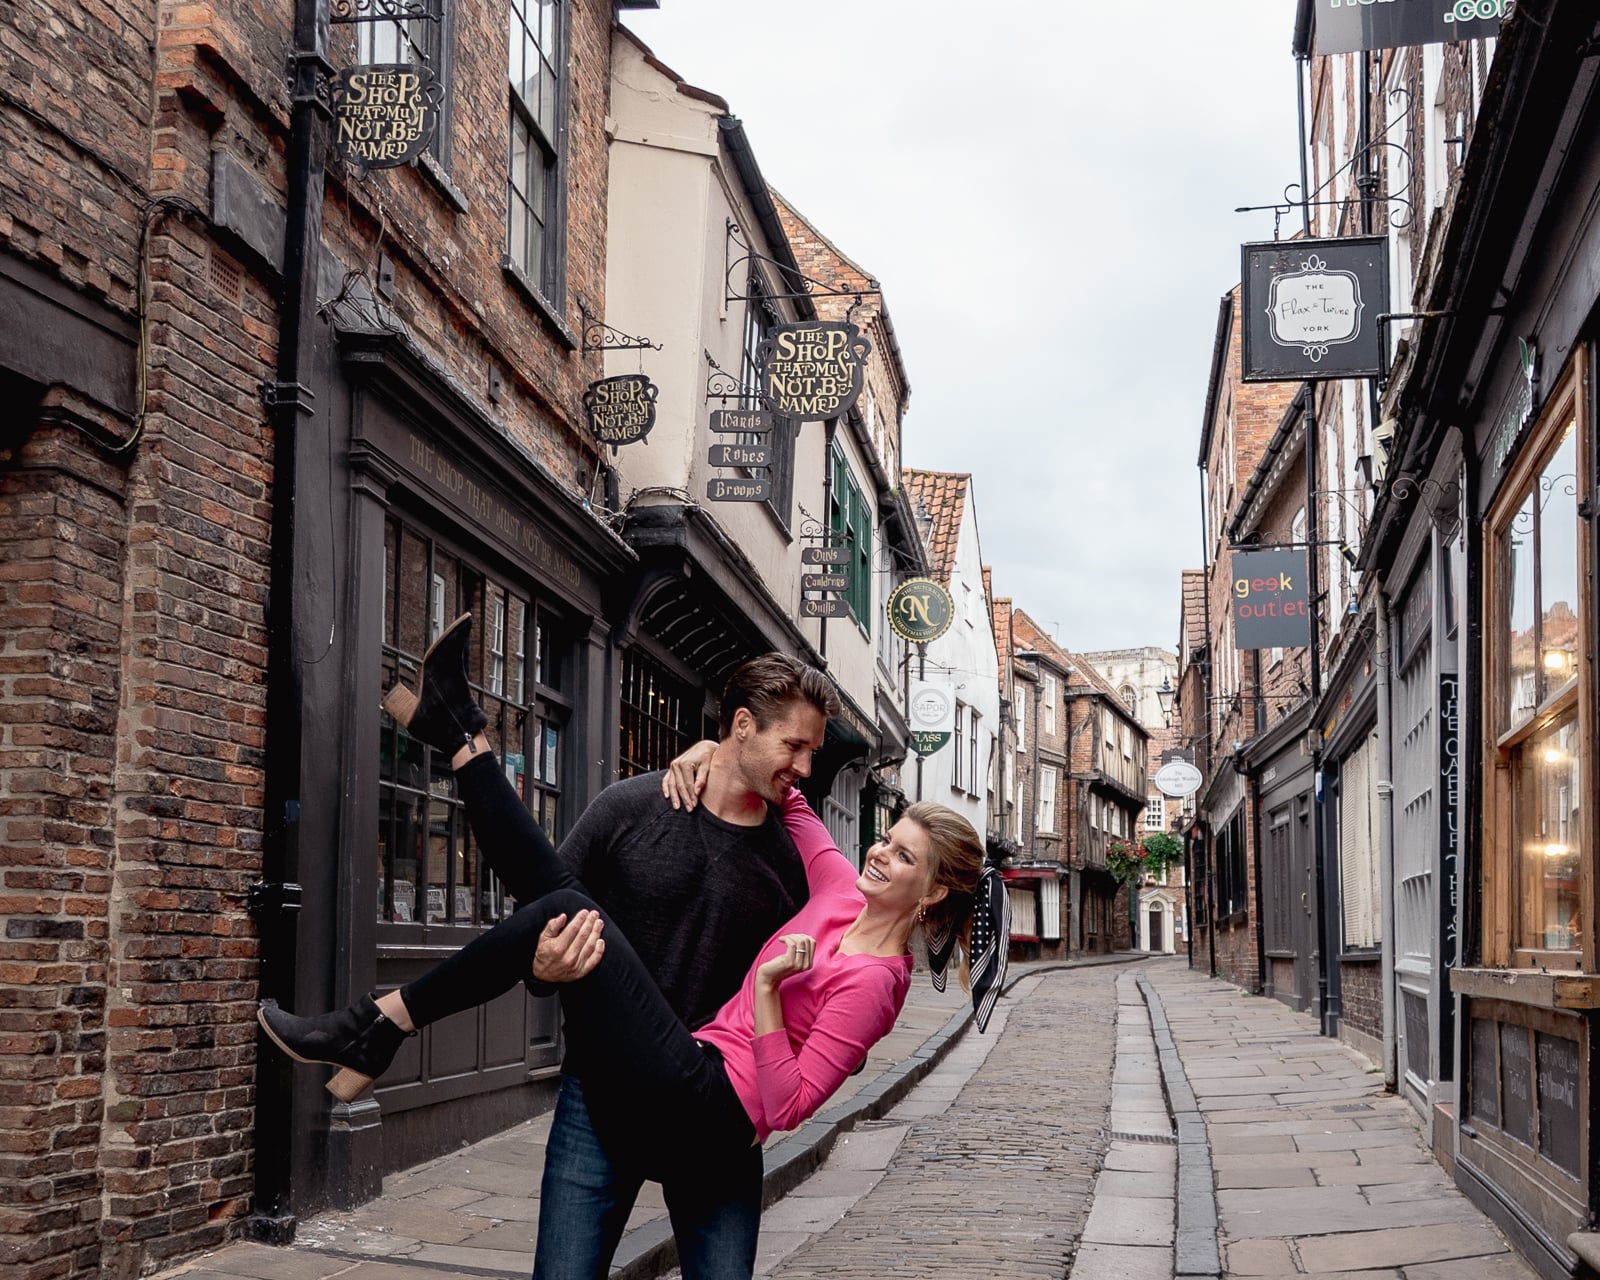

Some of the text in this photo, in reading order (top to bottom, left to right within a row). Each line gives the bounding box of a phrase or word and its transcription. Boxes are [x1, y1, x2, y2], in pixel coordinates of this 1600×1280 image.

[346, 73, 420, 105] SHOP
[367, 69, 400, 88] THE
[337, 86, 428, 133] THAT MUST
[337, 117, 420, 144] NOT BE
[347, 140, 408, 161] NAMED
[1281, 298, 1310, 320] Flax
[776, 330, 848, 362] SHOP
[796, 327, 827, 344] THE
[768, 344, 857, 388] THAT MUST
[596, 380, 643, 404] SHOP
[607, 379, 630, 391] THE
[769, 373, 851, 400] NOT BE
[591, 387, 650, 419] THAT MUST
[779, 396, 840, 415] NAMED
[593, 412, 648, 432] NOT BE
[720, 411, 761, 429] Wands
[600, 425, 642, 440] NAMED
[723, 446, 765, 463] Robes
[409, 433, 434, 473] THE
[435, 455, 464, 496] SHOP
[466, 479, 493, 520] THAT
[715, 481, 762, 498] Brooms
[1235, 572, 1293, 598] geek
[900, 595, 941, 627] N
[1238, 595, 1306, 619] outlet
